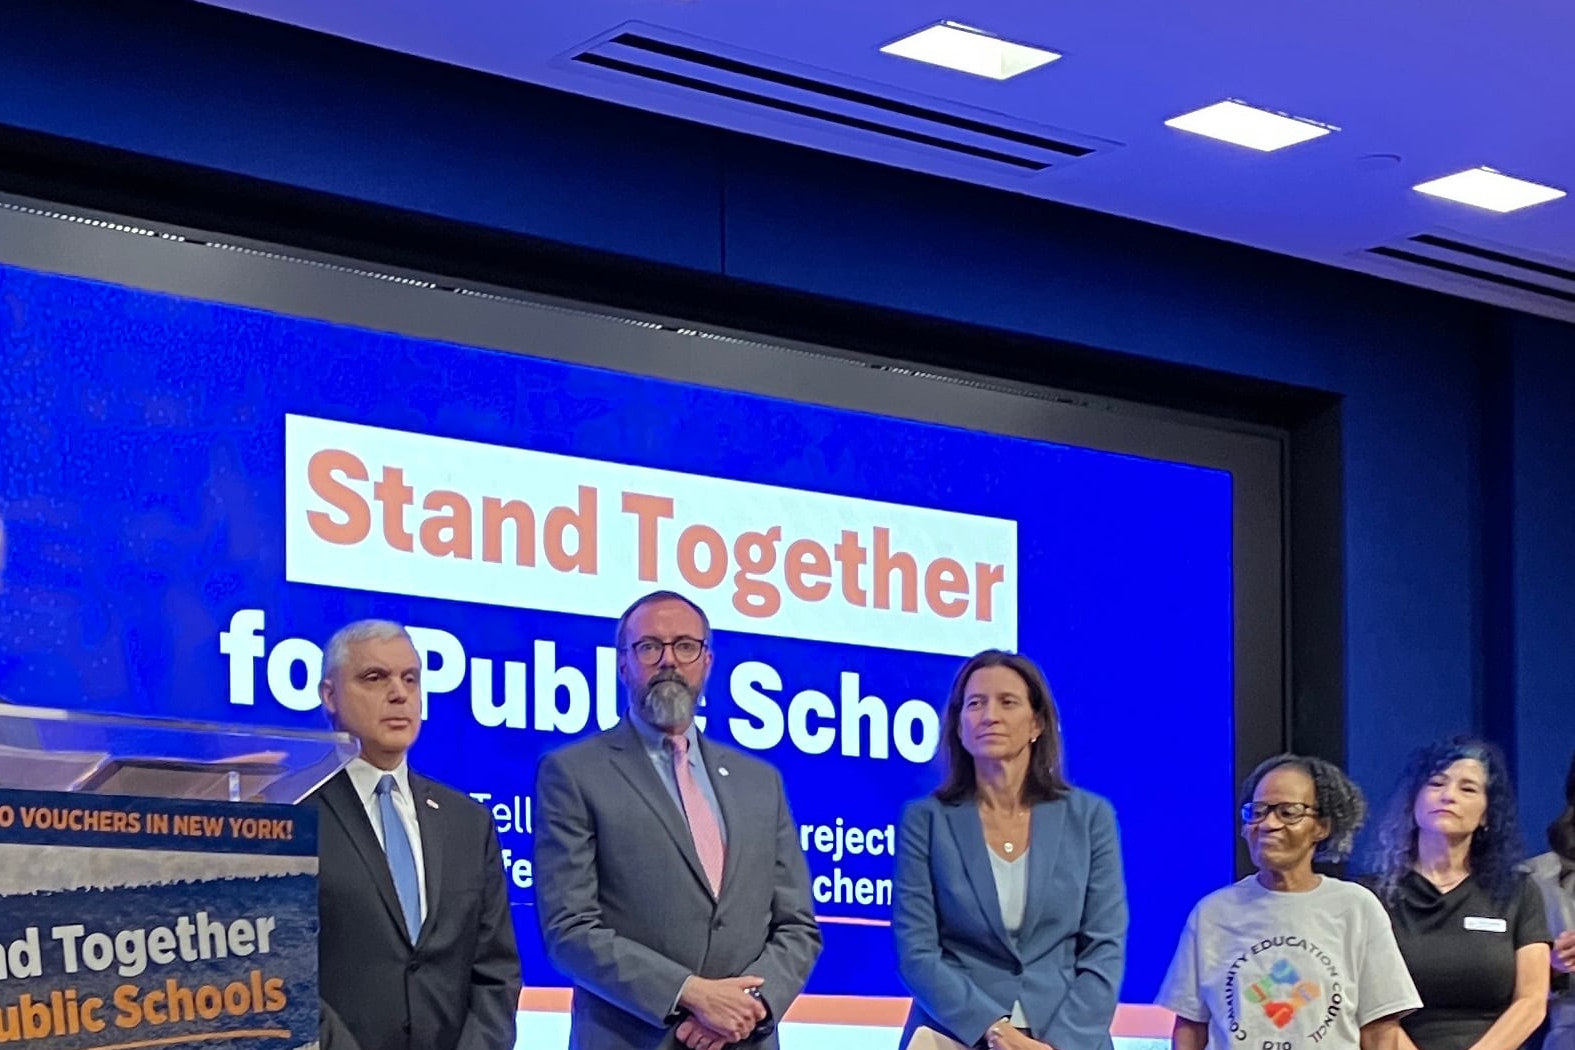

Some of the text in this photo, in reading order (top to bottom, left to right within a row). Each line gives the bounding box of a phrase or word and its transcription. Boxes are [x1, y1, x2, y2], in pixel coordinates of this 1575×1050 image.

[306, 448, 1006, 621] Stand Together
[220, 608, 325, 711] fo
[728, 660, 942, 764] Scho
[20, 807, 141, 835] VOUCHERS
[146, 813, 169, 834] IN
[173, 814, 223, 837] NEW
[229, 817, 294, 841] YORK!
[52, 910, 276, 977] Together
[115, 970, 286, 1028] Schools
[1225, 936, 1343, 1043] COMMUNITY EDUCATION COUNCIL
